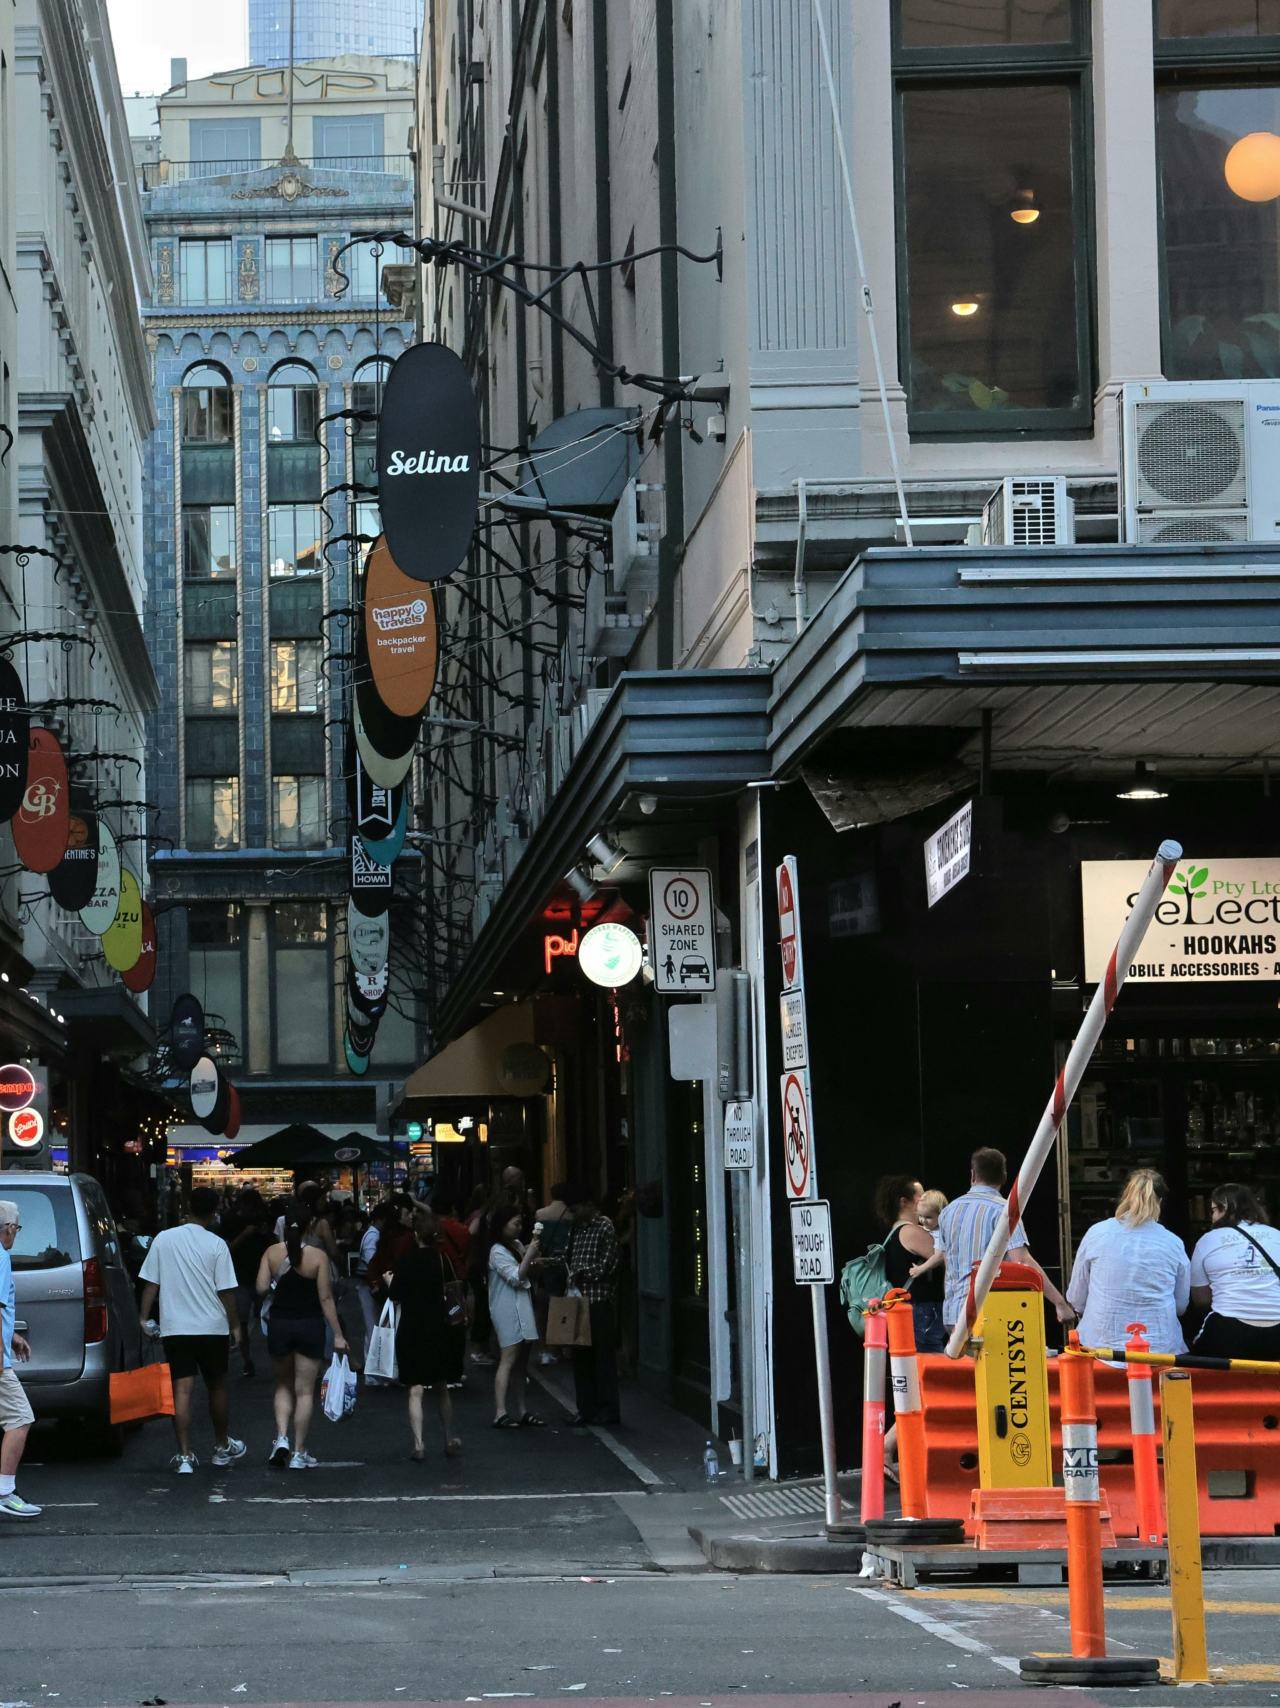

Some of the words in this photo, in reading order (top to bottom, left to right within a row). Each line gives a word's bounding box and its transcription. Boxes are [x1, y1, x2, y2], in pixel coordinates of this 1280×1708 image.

[386, 450, 470, 476] Selina
[373, 606, 412, 620] happy
[380, 613, 422, 629] travels
[377, 636, 426, 647] backpacker
[390, 645, 415, 654] travel
[64, 849, 95, 860] ENTINE'S
[1213, 880, 1246, 898] Pty
[673, 889, 689, 909] 10
[582, 925, 611, 947] FLINDERS
[612, 925, 639, 946] WAFFLES
[661, 924, 705, 937] SHARED
[669, 939, 698, 951] ZONE
[1184, 935, 1277, 955] HOOKAHS
[1127, 964, 1165, 978] OBILE
[1170, 962, 1259, 977] ACCESSORIES
[733, 1106, 742, 1121] NO
[727, 1127, 751, 1142] THROUGH
[730, 1149, 748, 1163] ROAD
[800, 1209, 812, 1227] NO
[795, 1233, 825, 1252] THROUGH
[800, 1258, 822, 1276] ROAD
[1006, 1319, 1030, 1430] CENTSYS
